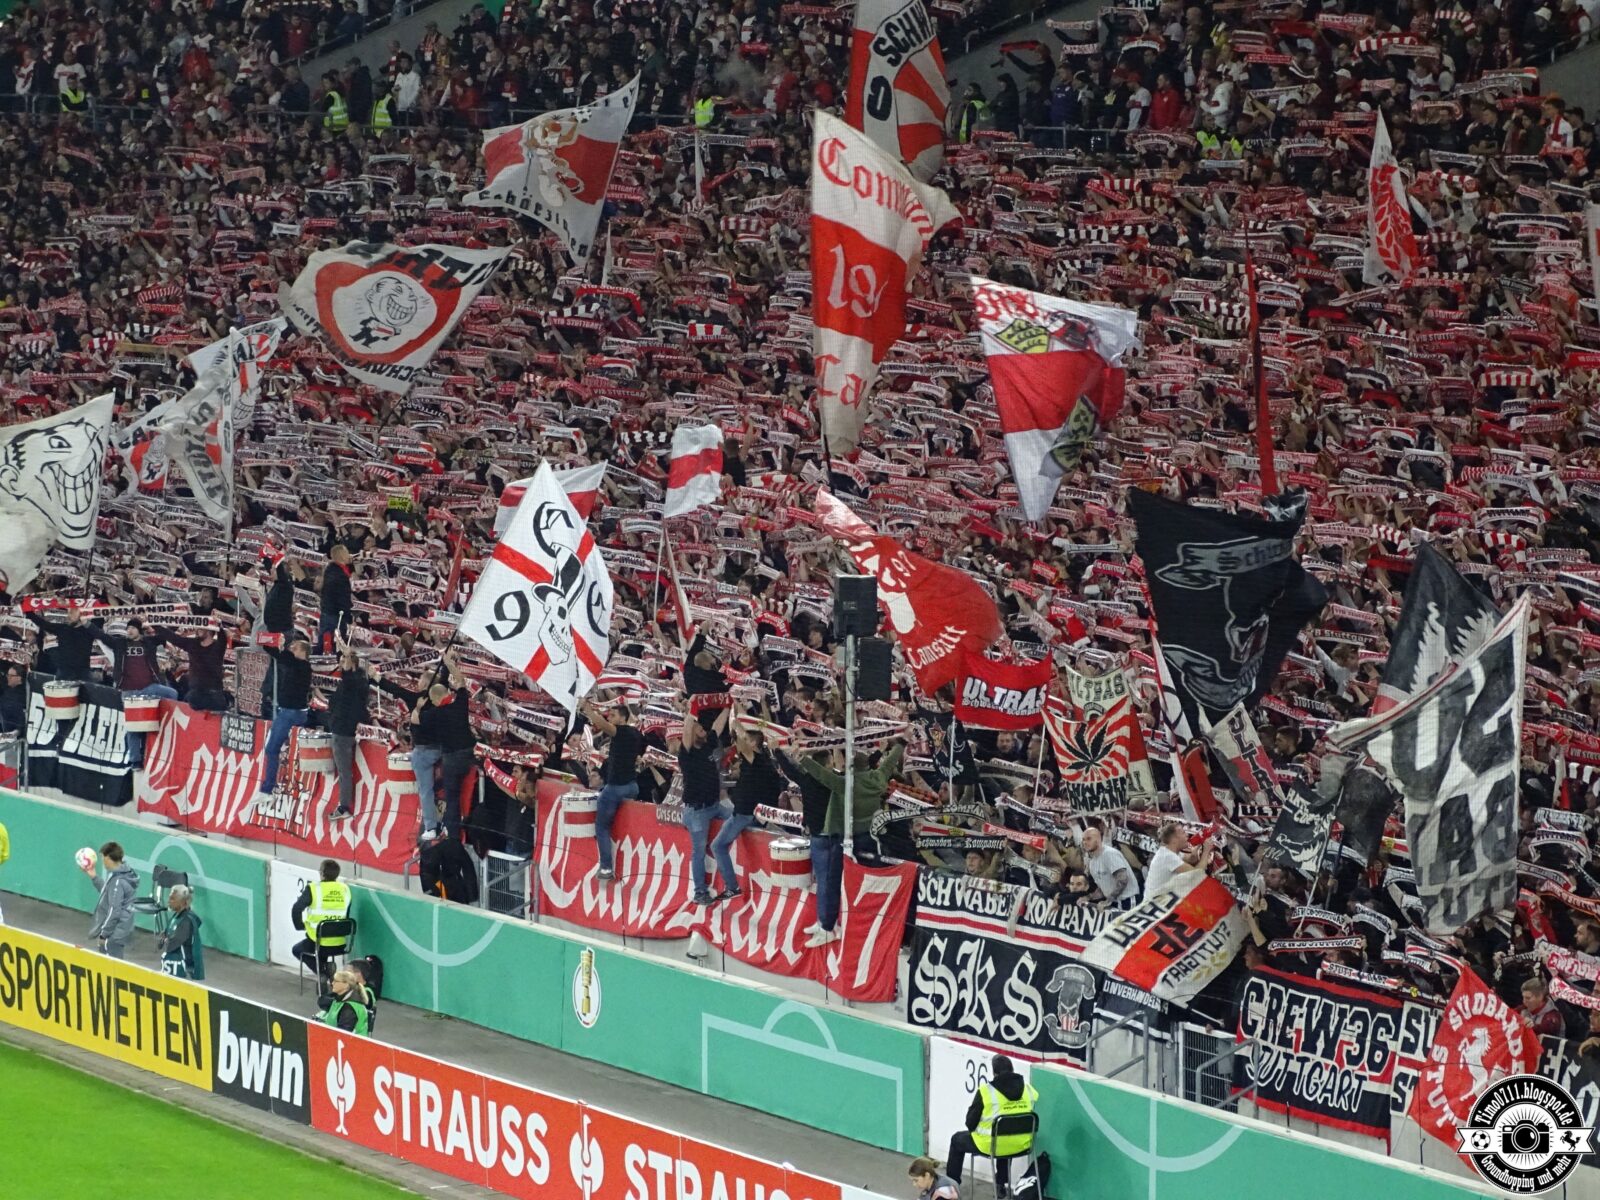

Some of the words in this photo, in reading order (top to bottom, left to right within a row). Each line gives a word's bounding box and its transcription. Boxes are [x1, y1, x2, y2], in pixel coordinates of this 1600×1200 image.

[93, 604, 175, 618] COMMANDO
[147, 614, 209, 627] COMMANDO
[379, 651, 441, 671] COMMANDO
[962, 677, 1047, 710] ULTRAS
[1241, 805, 1281, 817] ULT
[911, 932, 1043, 1046] SKS
[0, 941, 203, 1071] SPORTWETTEN
[217, 1010, 304, 1107] bwin
[373, 1065, 550, 1186] STRAUSS
